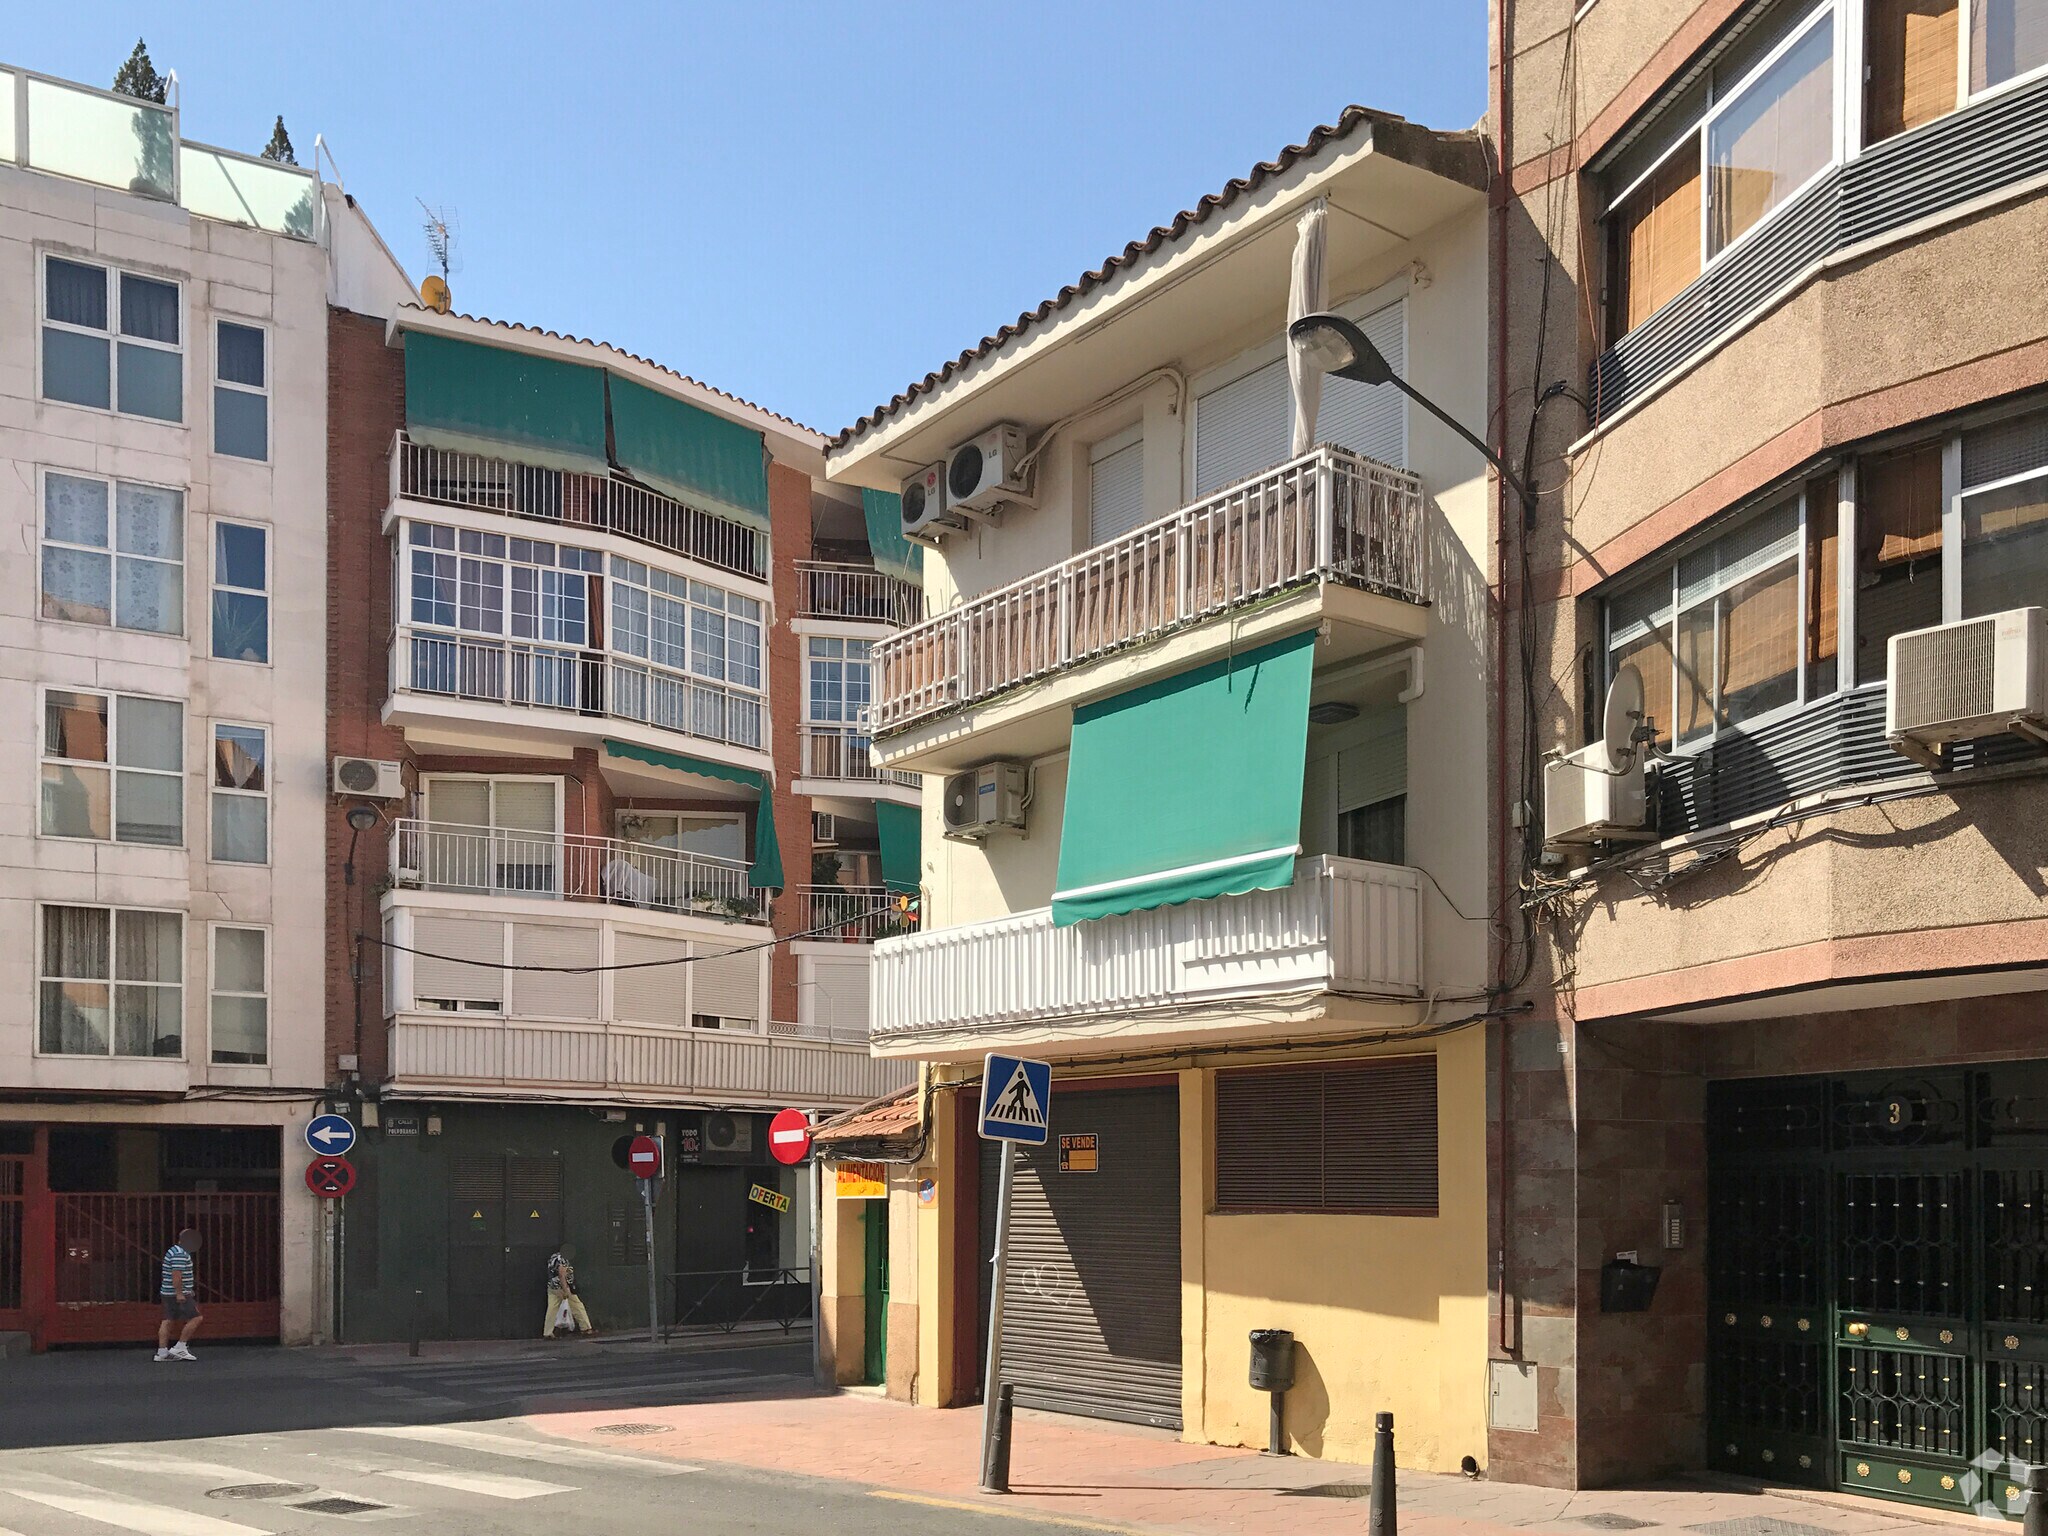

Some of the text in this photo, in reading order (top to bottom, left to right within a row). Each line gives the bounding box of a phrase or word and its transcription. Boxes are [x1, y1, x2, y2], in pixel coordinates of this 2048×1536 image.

[988, 449, 997, 459] LG
[927, 487, 936, 496] LG
[1889, 1103, 1900, 1124] 3
[681, 1129, 698, 1137] TODO
[1061, 1136, 1096, 1149] SE VENDE
[750, 1186, 788, 1211] OFERTA
